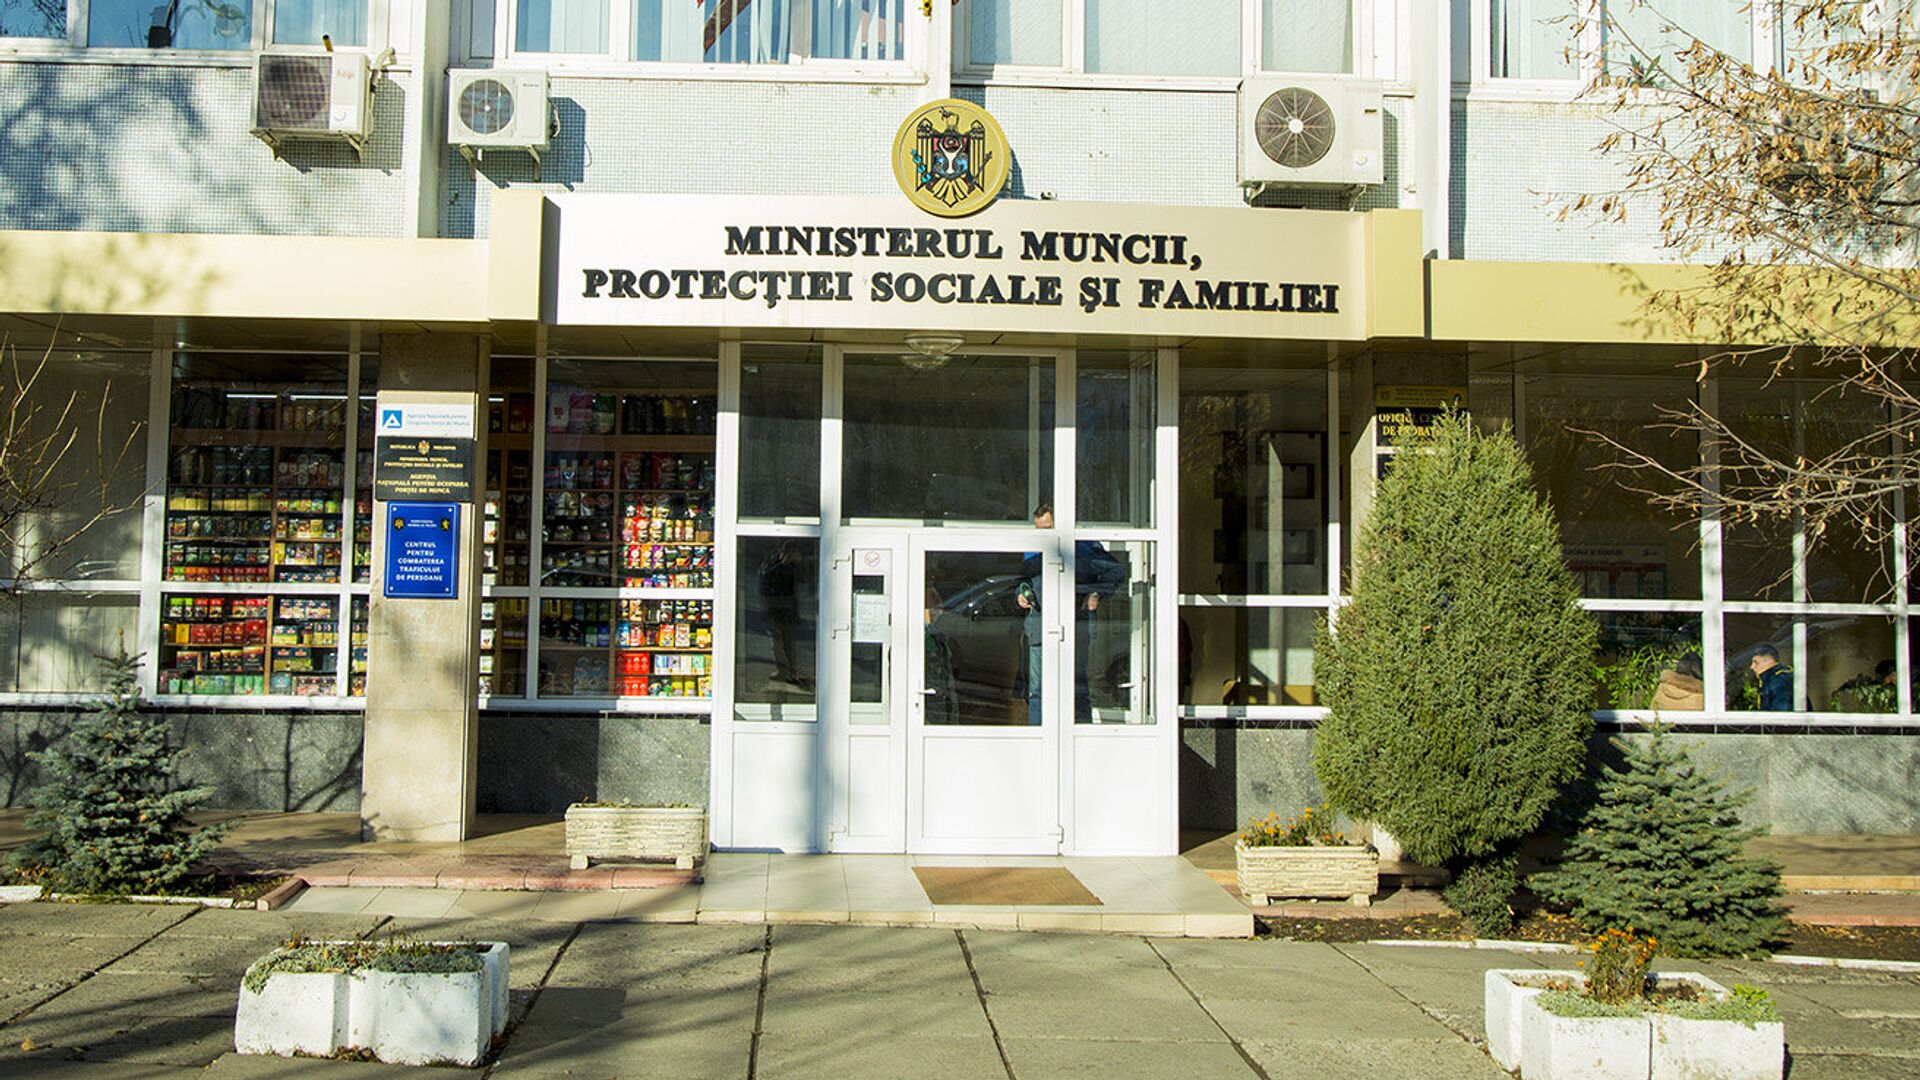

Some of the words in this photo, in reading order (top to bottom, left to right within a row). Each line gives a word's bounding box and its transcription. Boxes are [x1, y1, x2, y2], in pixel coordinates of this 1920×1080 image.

[724, 226, 1002, 260] MINISTERUL
[1020, 231, 1202, 271] MUNCII,
[582, 268, 853, 309] PROTECȚIEI
[871, 271, 1062, 308] SOCIALE
[1079, 277, 1121, 313] ȘI
[1138, 279, 1340, 313] FAMILIEI
